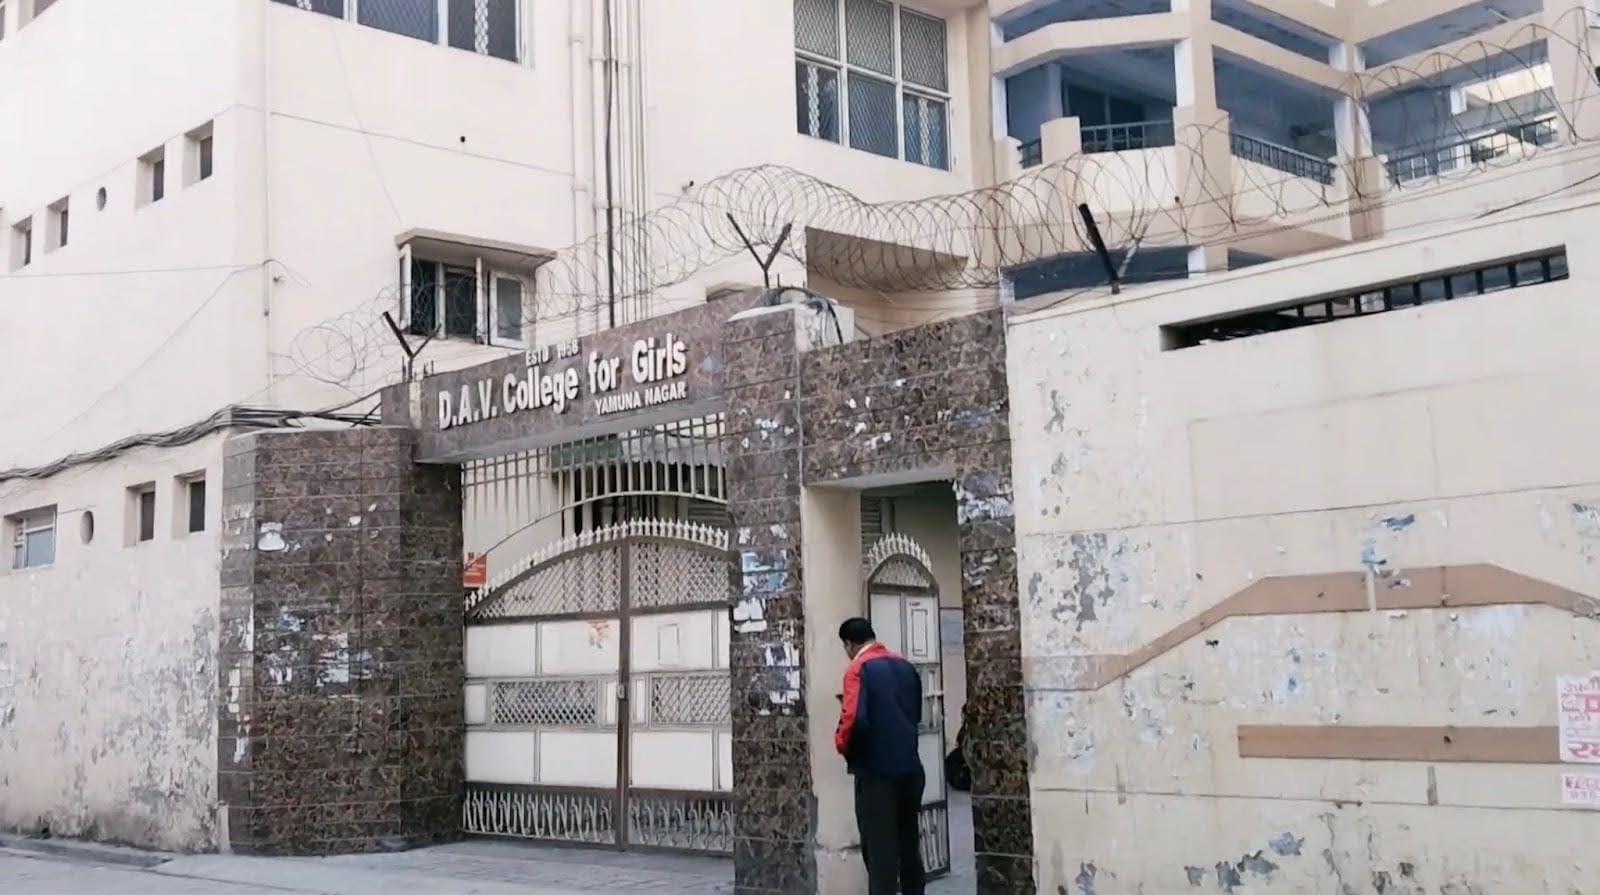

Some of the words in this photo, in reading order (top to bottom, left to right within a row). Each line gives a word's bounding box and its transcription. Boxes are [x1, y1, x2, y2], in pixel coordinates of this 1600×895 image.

[438, 378, 497, 430] D.A.V.
[503, 365, 579, 414] College
[588, 351, 620, 394] for
[632, 333, 687, 384] Girls
[595, 391, 641, 415] YAMUNA
[644, 382, 687, 406] NAGAR
